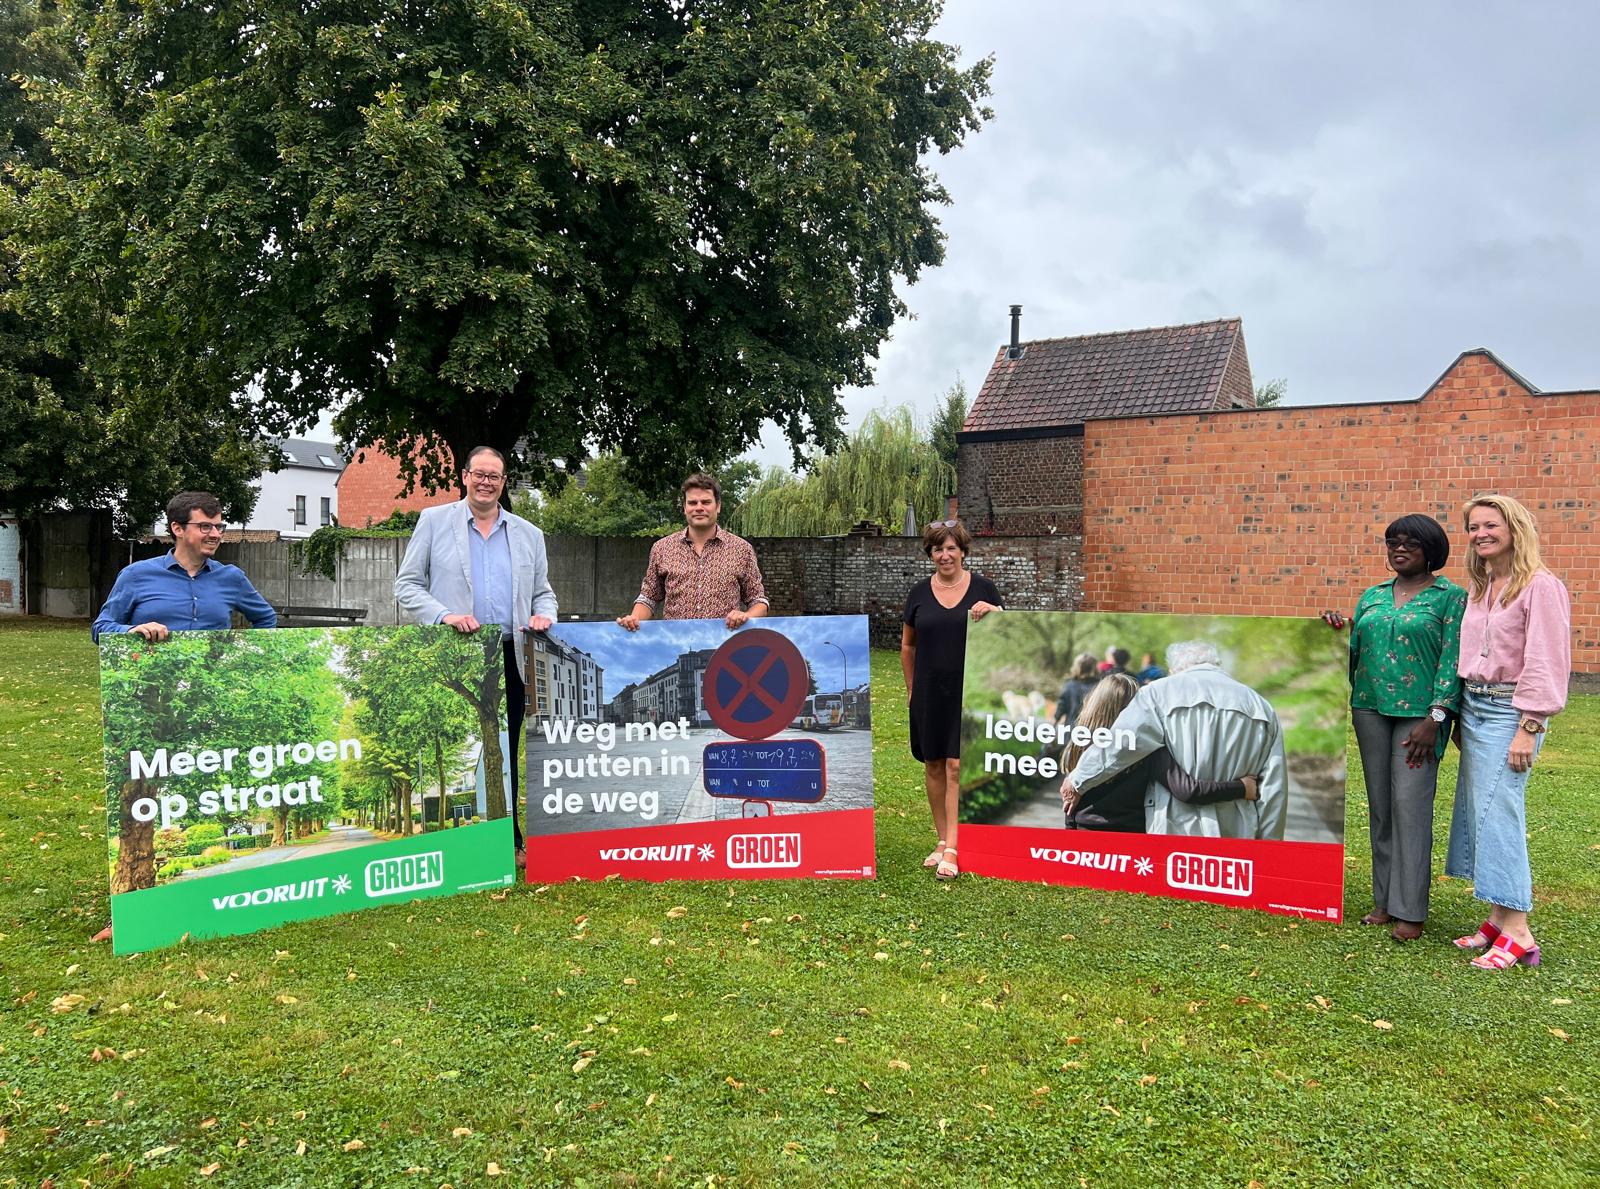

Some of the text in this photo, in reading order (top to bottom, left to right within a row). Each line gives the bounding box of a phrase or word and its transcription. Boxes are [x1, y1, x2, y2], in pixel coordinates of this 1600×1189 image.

[543, 716, 691, 751] Weg met
[985, 713, 1137, 751] Iedereen
[131, 738, 362, 780] Meer groen
[543, 748, 690, 787] putten in
[756, 751, 769, 759] TOT
[983, 752, 1059, 779] mee
[757, 779, 770, 788] TOT
[131, 775, 324, 830] op straat
[542, 787, 659, 820] de weg
[598, 843, 695, 863] VOORUIT
[731, 835, 799, 864] GROEN
[1029, 847, 1132, 874] VOORUIT
[369, 853, 442, 893] GROEN
[1172, 854, 1251, 892] GROEN
[211, 876, 330, 911] VOORUIT
